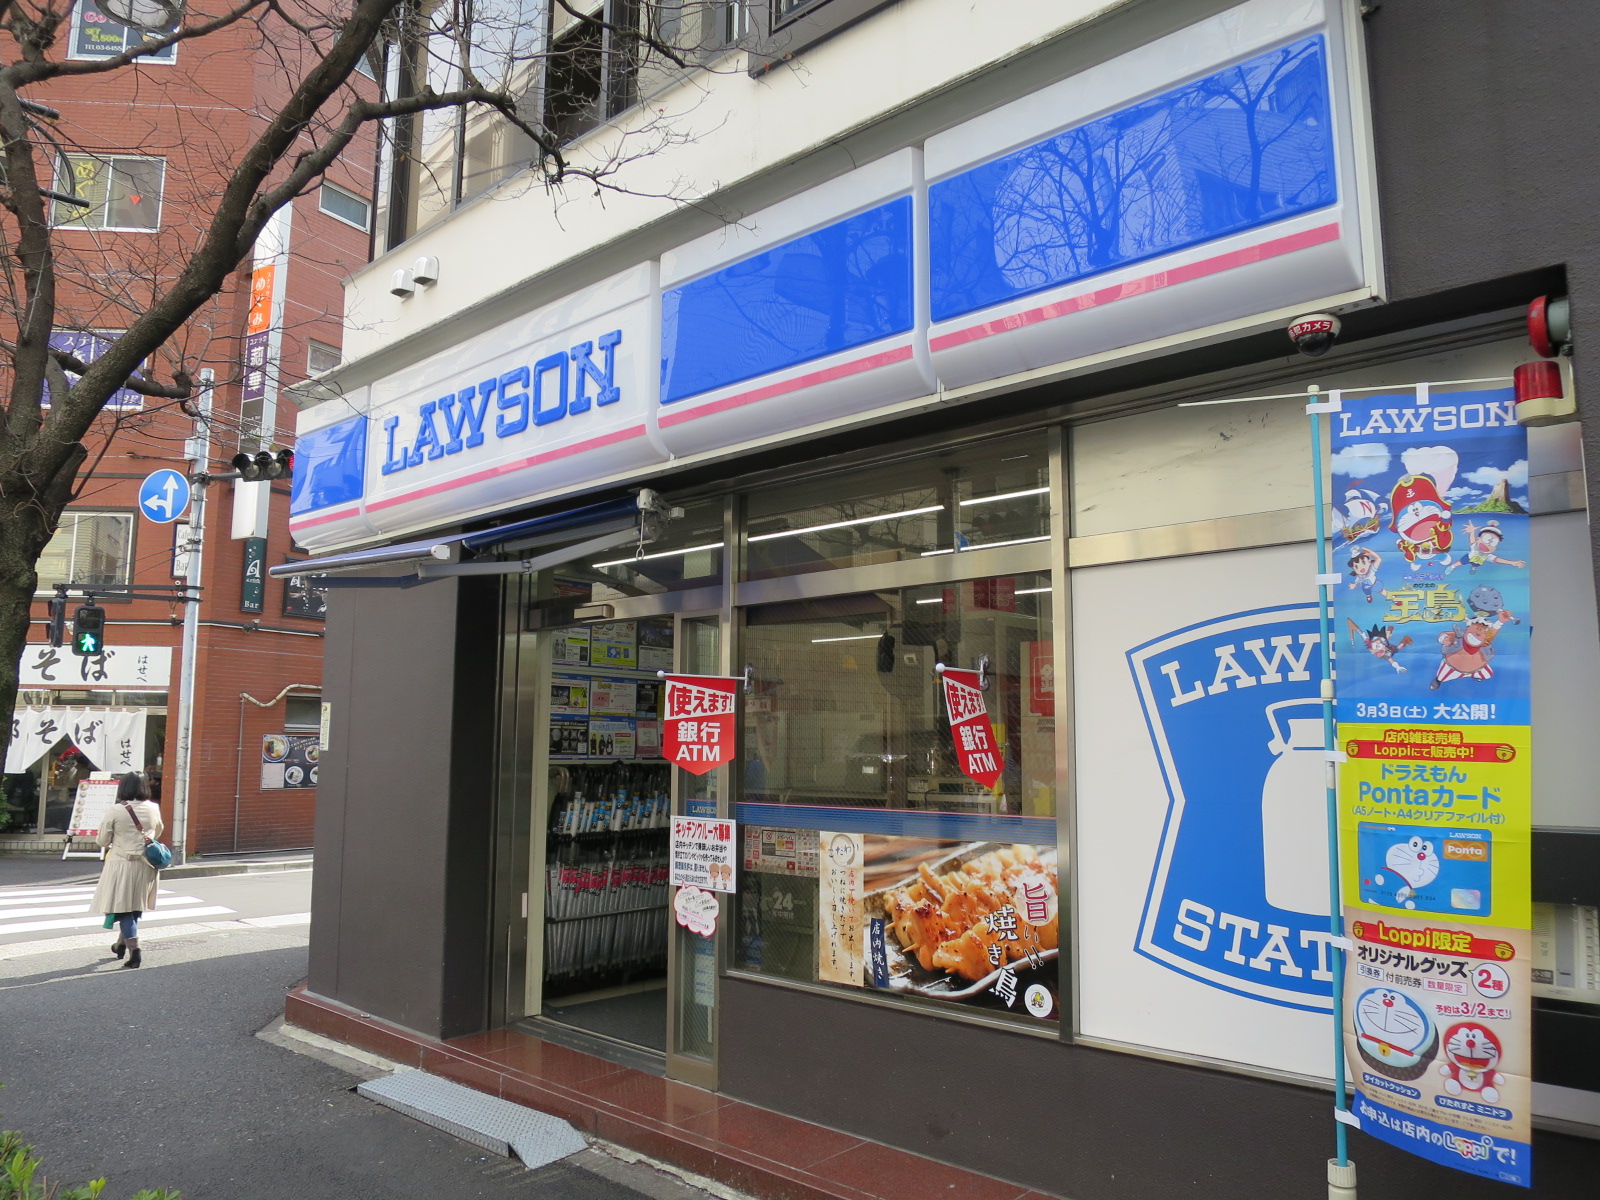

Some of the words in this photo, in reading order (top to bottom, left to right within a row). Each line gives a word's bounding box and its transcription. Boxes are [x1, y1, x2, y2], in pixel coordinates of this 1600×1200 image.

[381, 329, 622, 476] LAWSON
[1340, 401, 1517, 437] LAWSON
[244, 600, 259, 609] Bar
[32, 649, 115, 682] そば
[1160, 633, 1337, 707] LAW
[677, 720, 721, 743] 銀行
[959, 725, 988, 750] 銀行
[1384, 731, 1463, 750] 店内雑誌売場
[676, 744, 720, 762] ATM
[968, 752, 998, 774] ATM
[1381, 763, 1468, 784] ドラえもん
[1359, 782, 1503, 810] Pontaカード
[1448, 845, 1483, 855] Ponta
[773, 891, 794, 910] 24
[1377, 921, 1473, 953] Loppi限定
[871, 921, 885, 980] 店内焼き
[1357, 944, 1470, 979] オリジナルグッズ
[1385, 972, 1422, 989] 付前売券
[1427, 980, 1464, 994] 数量限定
[1478, 969, 1504, 992] 2種
